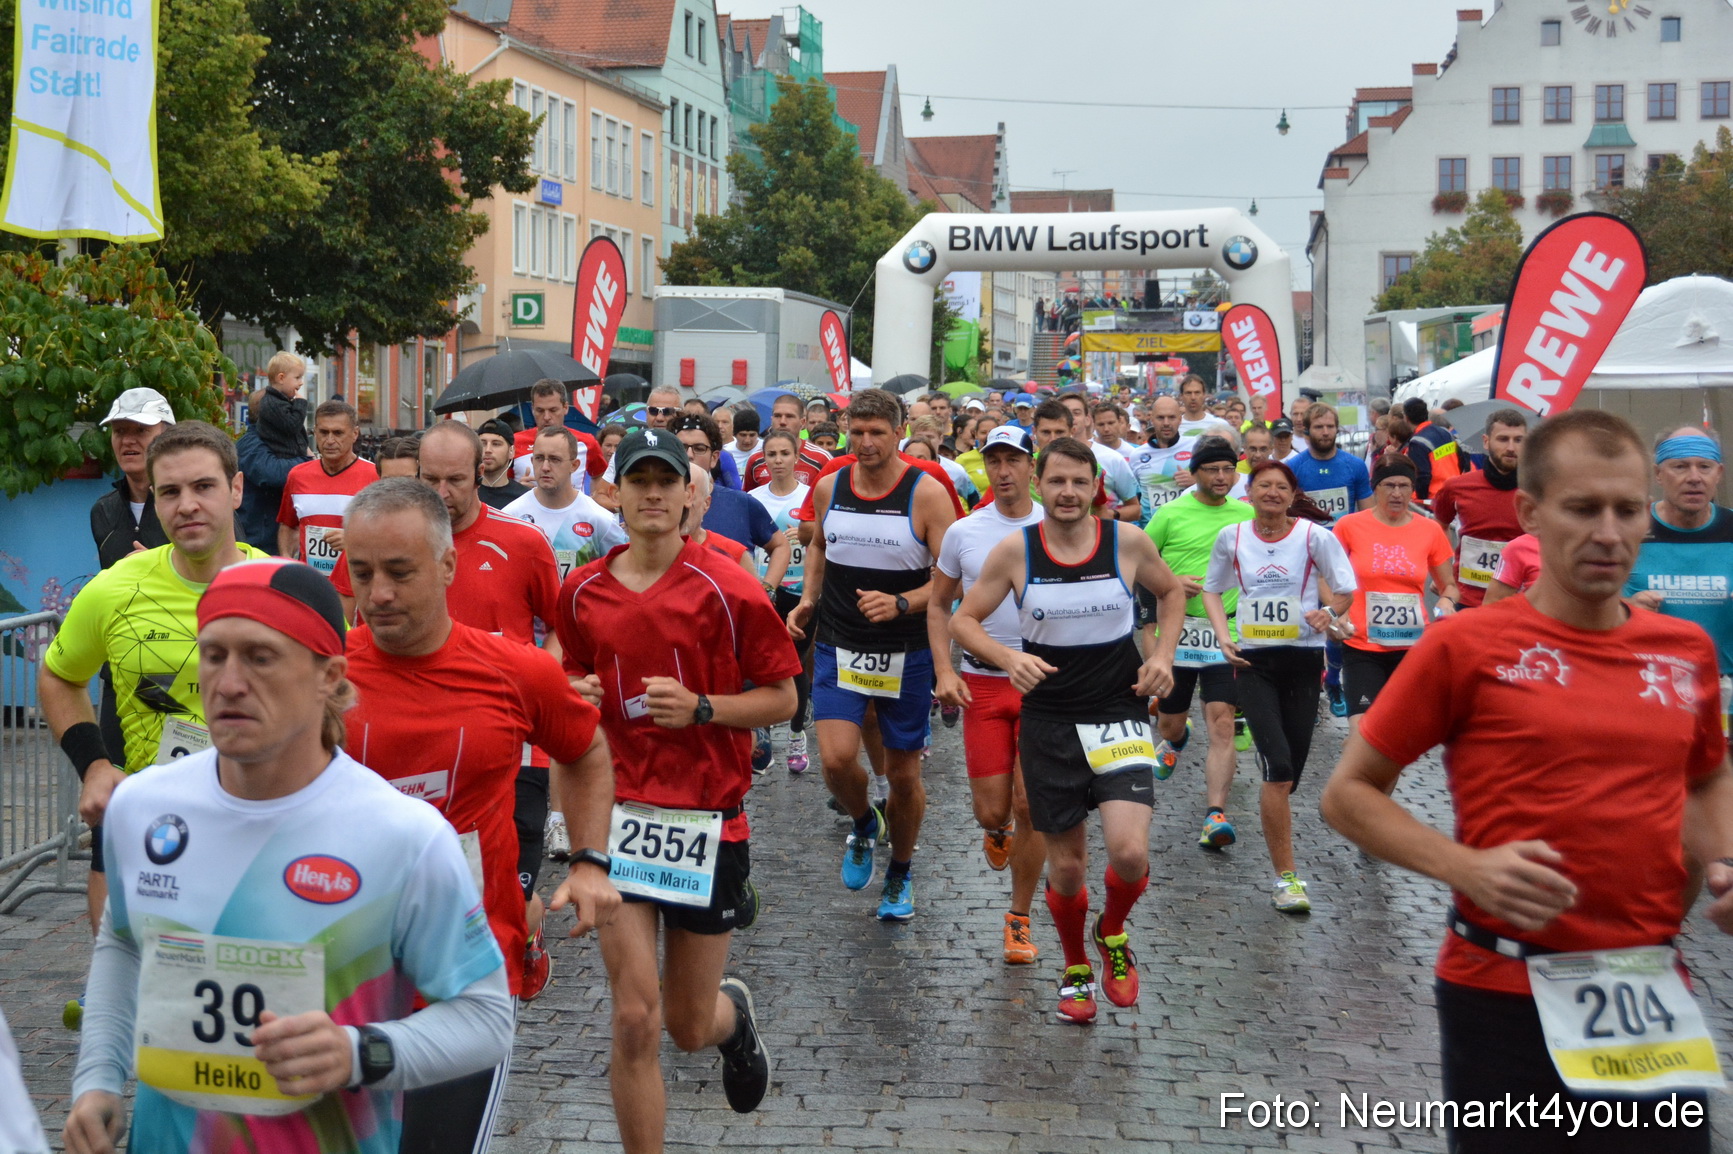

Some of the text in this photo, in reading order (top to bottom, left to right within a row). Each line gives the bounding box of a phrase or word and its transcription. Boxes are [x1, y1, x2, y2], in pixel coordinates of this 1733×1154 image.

[948, 223, 1209, 255] BMW Laufsport
[517, 298, 538, 320] D
[1506, 241, 1625, 414] REWE
[1136, 337, 1167, 348] ZIEL
[1230, 315, 1276, 397] REWE
[1318, 496, 1345, 512] 919
[838, 534, 866, 543] Autohaus
[313, 560, 334, 570] Micha
[1471, 572, 1492, 582] Matth
[1648, 574, 1727, 590] HUBER
[1665, 590, 1724, 598] TECHNOLOGY
[1046, 608, 1080, 616] Autohaus
[1101, 603, 1120, 611] LELL
[1251, 600, 1289, 623] 146
[1371, 605, 1418, 625] 2231
[1252, 628, 1285, 638] Irmgard
[1377, 629, 1413, 638] Rosalinde
[850, 651, 891, 673] 259
[1184, 651, 1217, 661] Bernhard
[850, 675, 884, 687] Maurice
[1495, 665, 1544, 682] Spitz
[173, 729, 208, 745] NeuerMarkt
[1111, 744, 1144, 758] Flocke
[400, 781, 426, 796] EHN
[618, 818, 708, 867] 2554
[139, 871, 180, 890] PARTL
[293, 863, 353, 893] Hervis
[614, 862, 700, 891] Julius Maria
[136, 886, 179, 901] Neumarkt
[155, 949, 207, 965] NeuerMarkt
[216, 943, 306, 969] BOCK
[192, 979, 266, 1048] 39
[1575, 981, 1675, 1040] 204
[1591, 1050, 1689, 1077] Christian
[195, 1061, 262, 1091] Heiko
